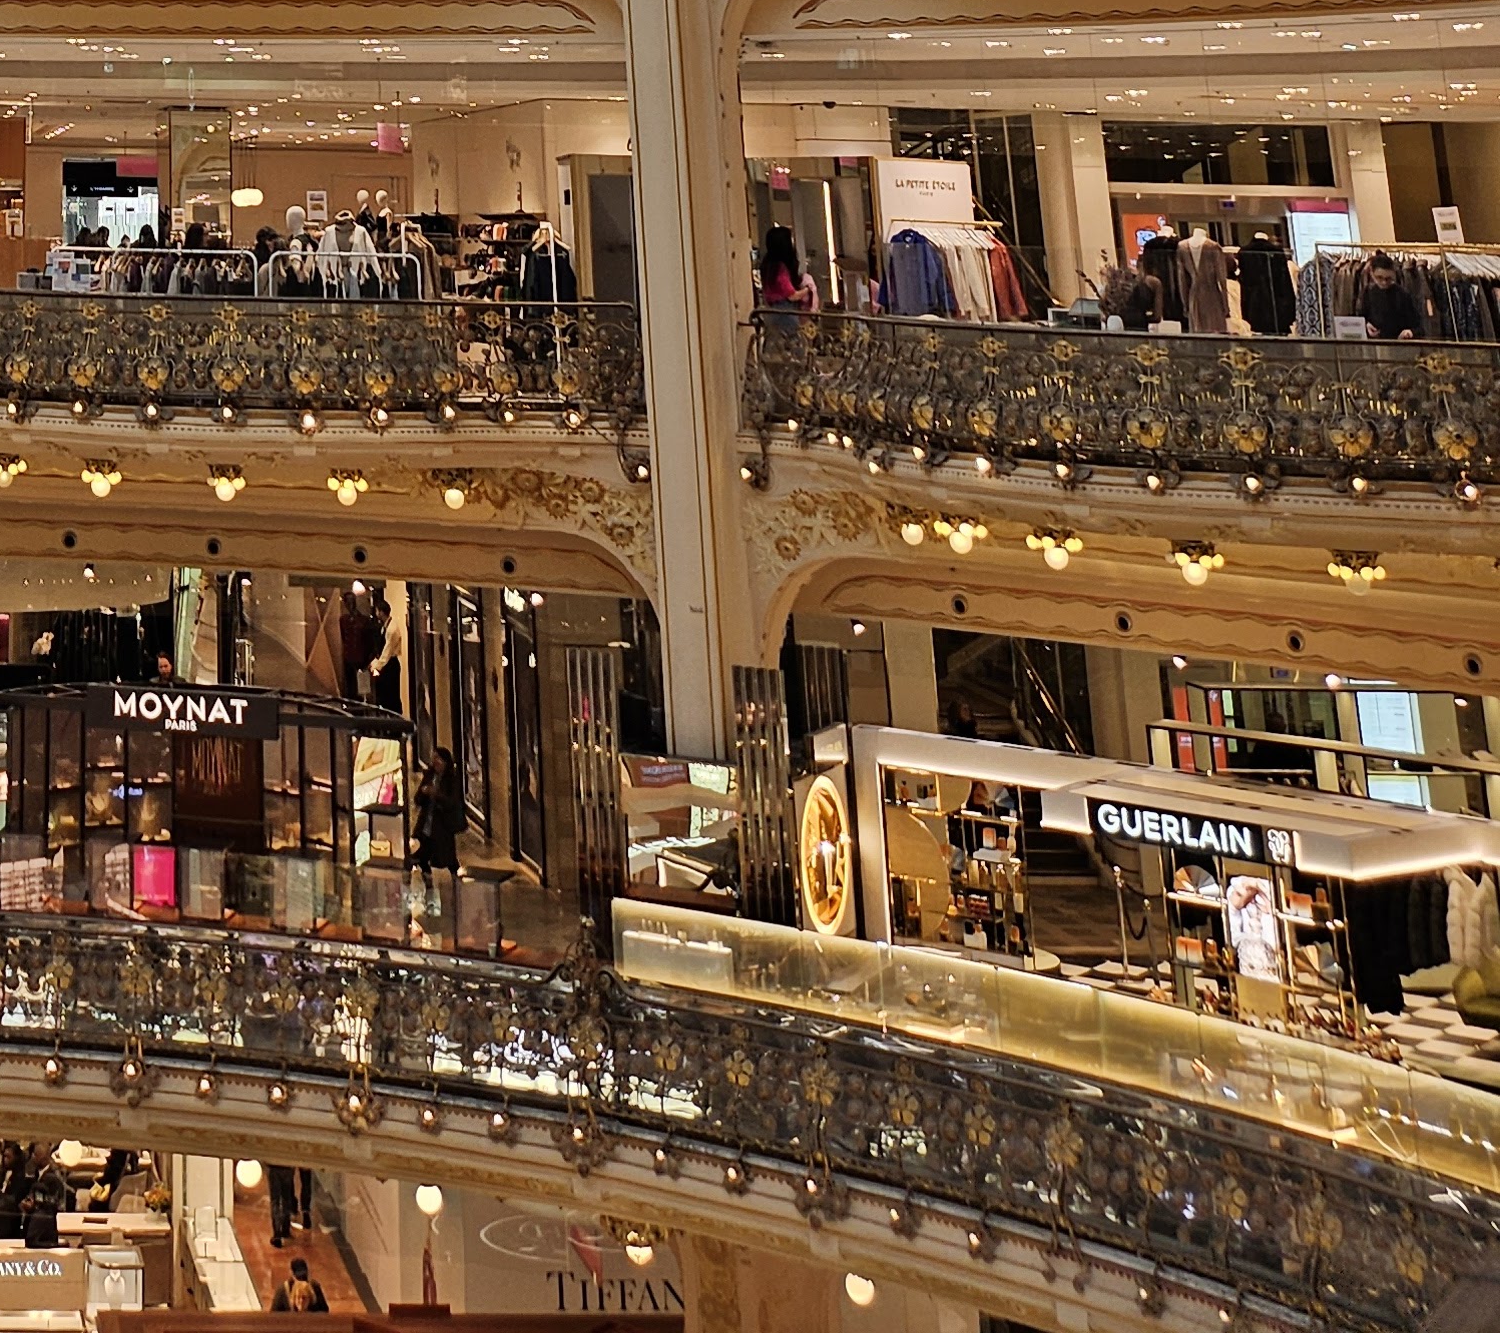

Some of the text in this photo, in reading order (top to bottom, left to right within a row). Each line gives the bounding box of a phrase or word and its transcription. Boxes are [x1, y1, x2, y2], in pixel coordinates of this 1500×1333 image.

[113, 689, 249, 725] MOYNAT
[164, 718, 198, 732] PARIS
[1097, 803, 1253, 858] GUERLAIN
[546, 1270, 685, 1311] TIFFAN
